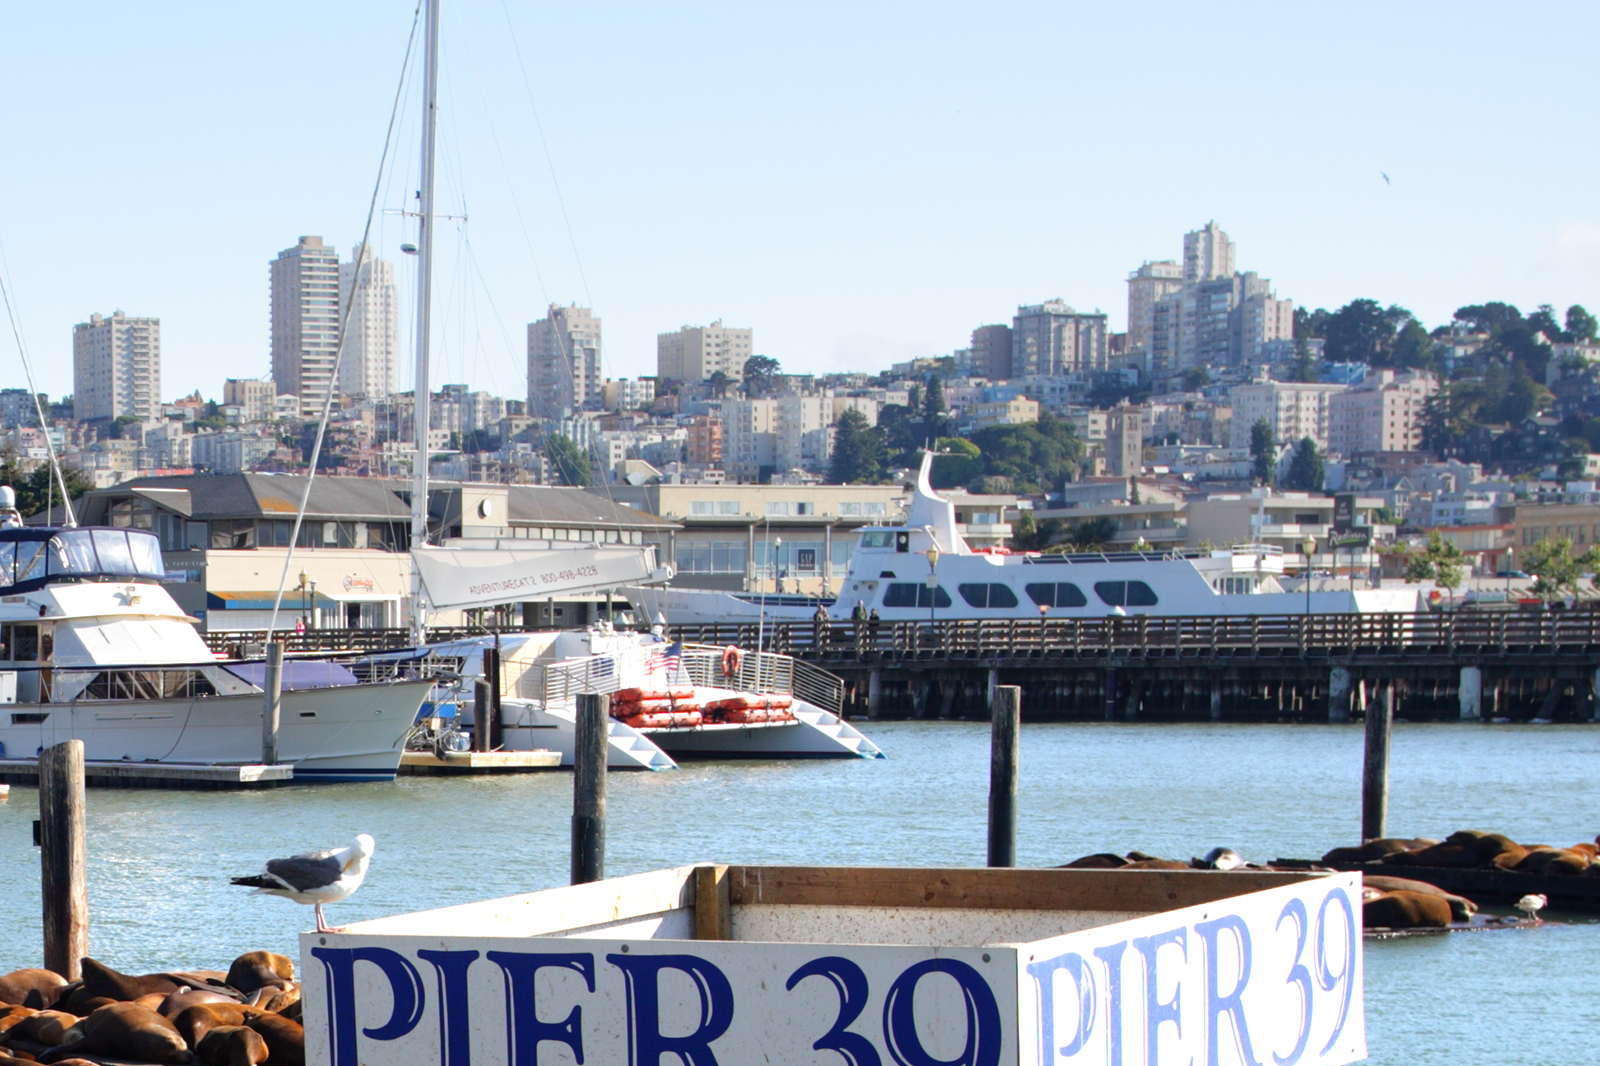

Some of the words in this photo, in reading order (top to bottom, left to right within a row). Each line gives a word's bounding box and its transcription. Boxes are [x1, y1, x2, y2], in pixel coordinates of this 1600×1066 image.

[1329, 528, 1367, 547] Radisson
[800, 553, 812, 563] GAP
[539, 564, 599, 585] 800-498-4228
